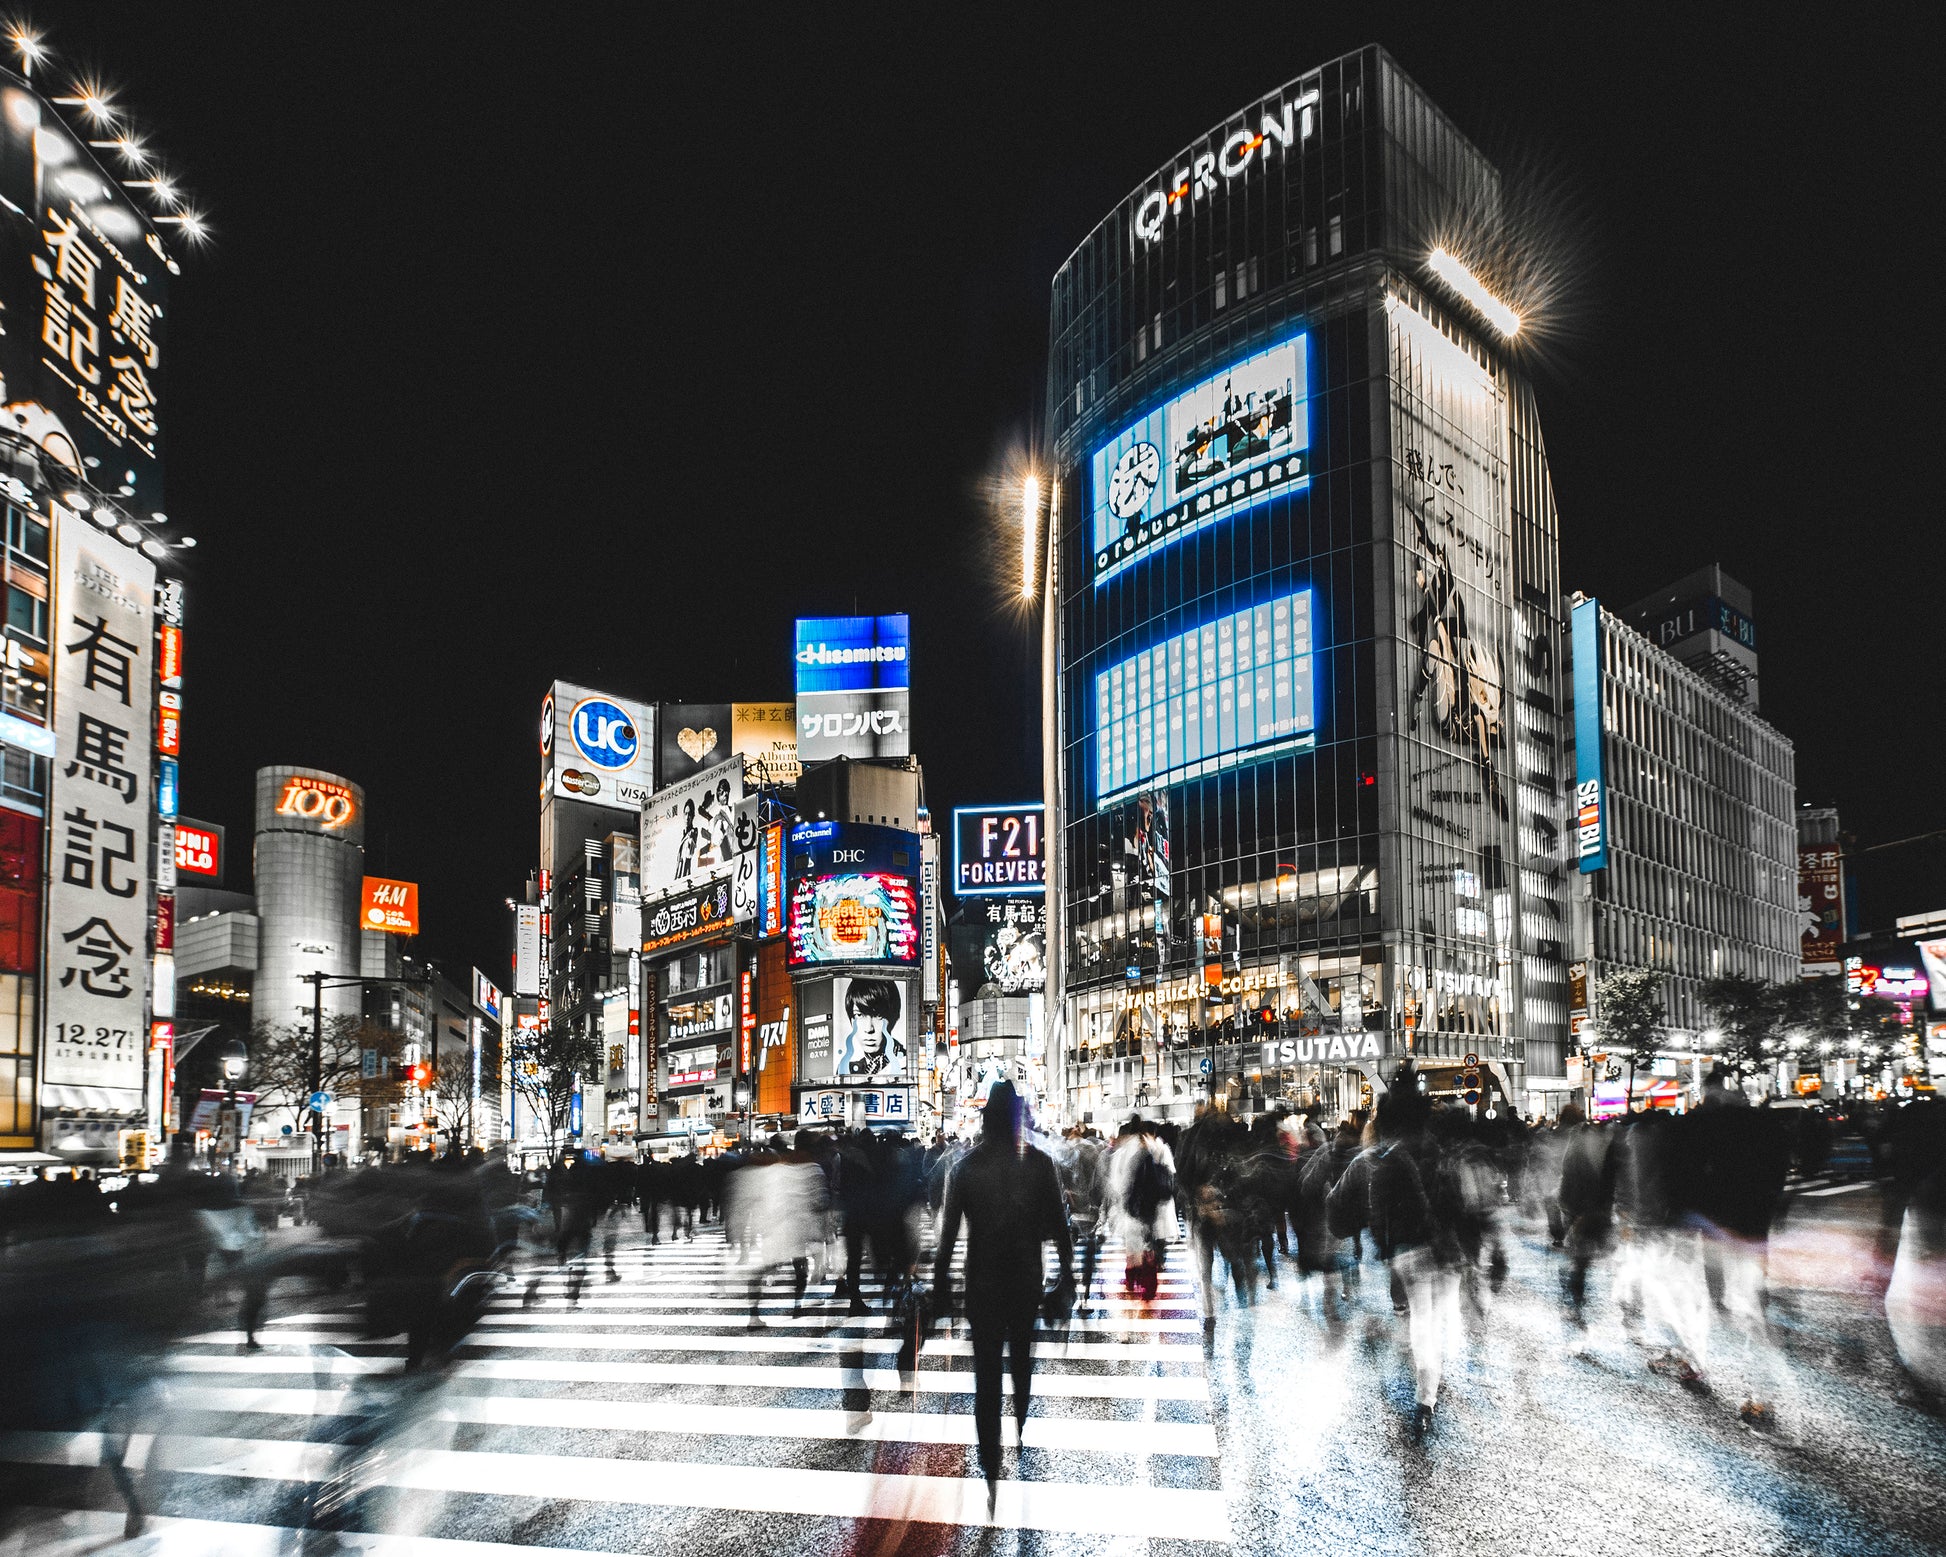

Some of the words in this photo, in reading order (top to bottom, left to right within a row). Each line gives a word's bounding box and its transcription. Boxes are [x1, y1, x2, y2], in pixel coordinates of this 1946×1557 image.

[1135, 89, 1319, 242] QFRONT
[1440, 506, 1500, 591] スッキリ。
[796, 643, 905, 664] Hisamitsu
[802, 711, 903, 738] サロンパス
[760, 752, 797, 760] Album
[772, 742, 797, 751] New
[292, 777, 351, 799] SHIBUYA
[621, 787, 648, 801] VISA
[644, 760, 740, 811] アーティストとのコラボレーションアルバム!
[59, 615, 139, 998] 有馬記念
[276, 786, 354, 829] 109
[1578, 779, 1601, 857] SEIBU
[792, 832, 805, 841] DHC
[806, 828, 832, 838] Channel
[982, 815, 1037, 858] F21
[734, 811, 756, 915] もんじゃ
[833, 850, 865, 863] DHC
[961, 860, 1037, 883] FOREVER
[373, 884, 408, 907] H&M
[986, 904, 1046, 922] 有馬記念
[924, 916, 933, 960] neon
[1118, 982, 1209, 1011] STARBUCKS
[1219, 971, 1288, 994] COFFEE
[56, 1023, 127, 1048] 12.27
[670, 1020, 715, 1038] Euphoria
[808, 1026, 829, 1040] DMM
[808, 1039, 830, 1050] mobile
[1264, 1034, 1380, 1064] TSUTAYA
